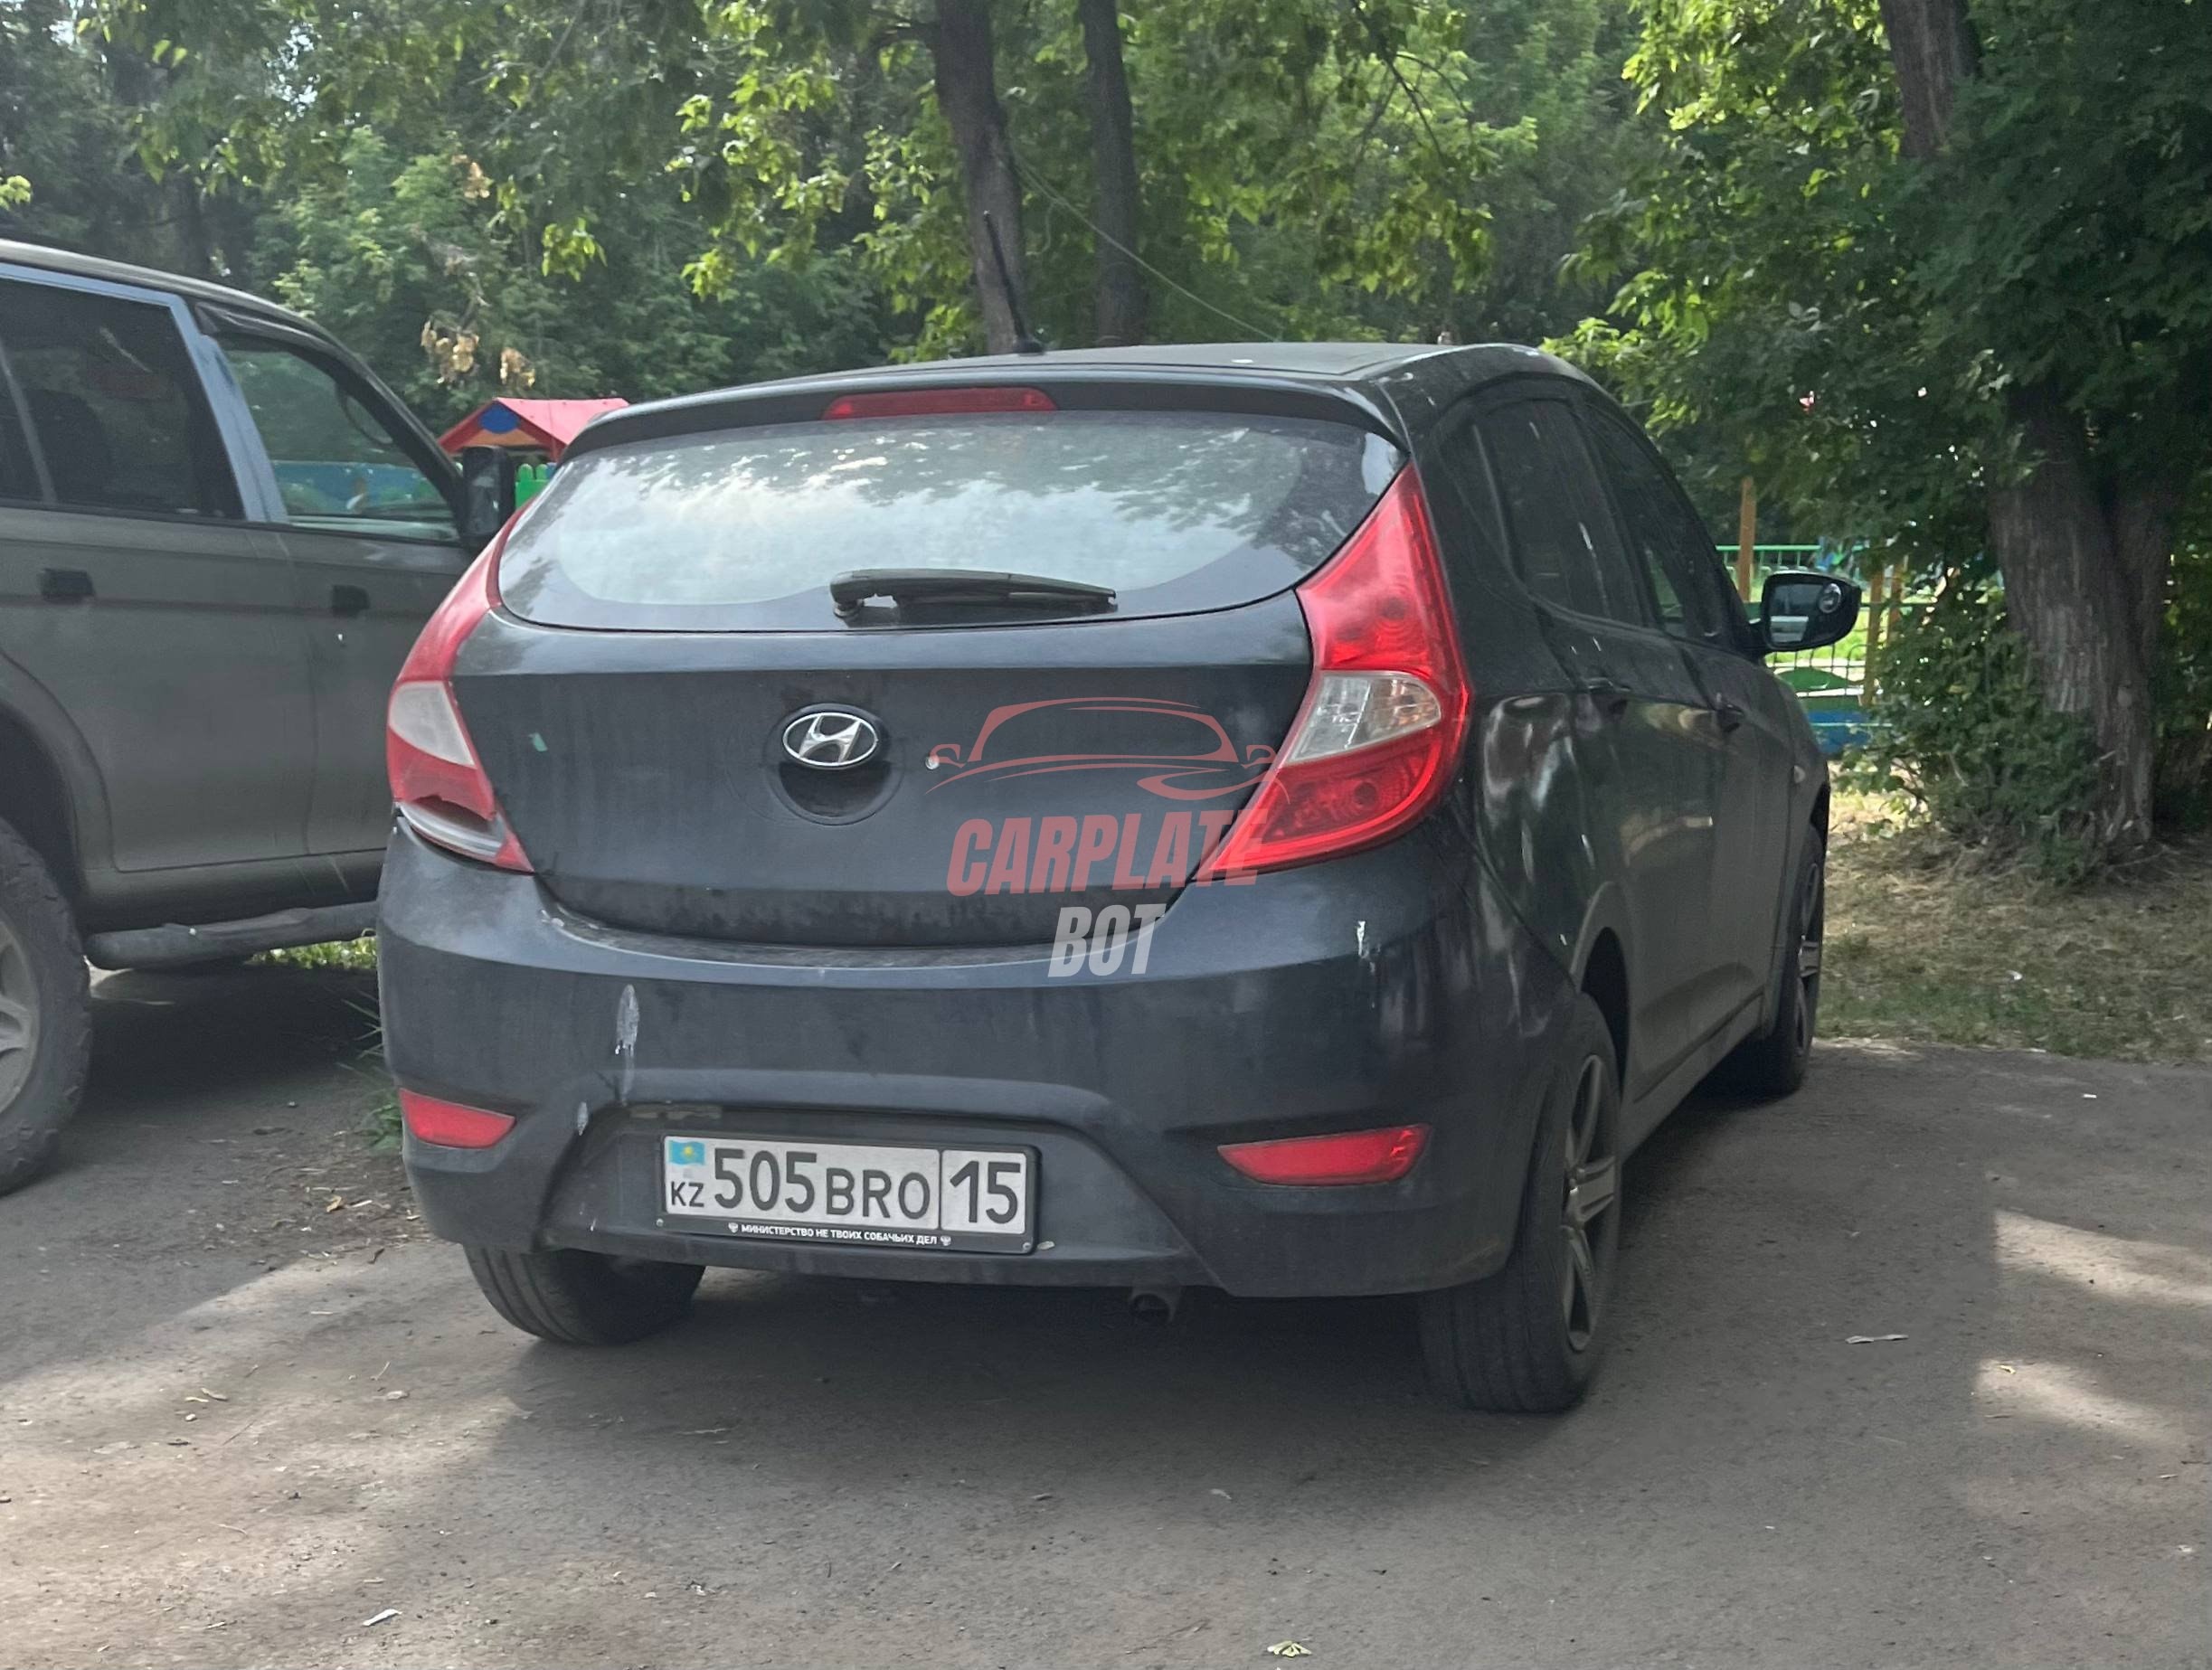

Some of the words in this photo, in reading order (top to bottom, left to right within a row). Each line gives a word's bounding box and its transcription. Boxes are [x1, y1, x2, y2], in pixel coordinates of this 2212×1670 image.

[670, 1181, 704, 1208] KZ
[950, 1160, 1022, 1224] 15
[741, 1224, 814, 1238] МИНИСТЕРСТВО
[816, 1229, 828, 1238] НЕ
[830, 1230, 863, 1240] ТВОИХ
[864, 1231, 915, 1243] СОБАЧЬИХ
[916, 1235, 937, 1245] ДЕЛ
